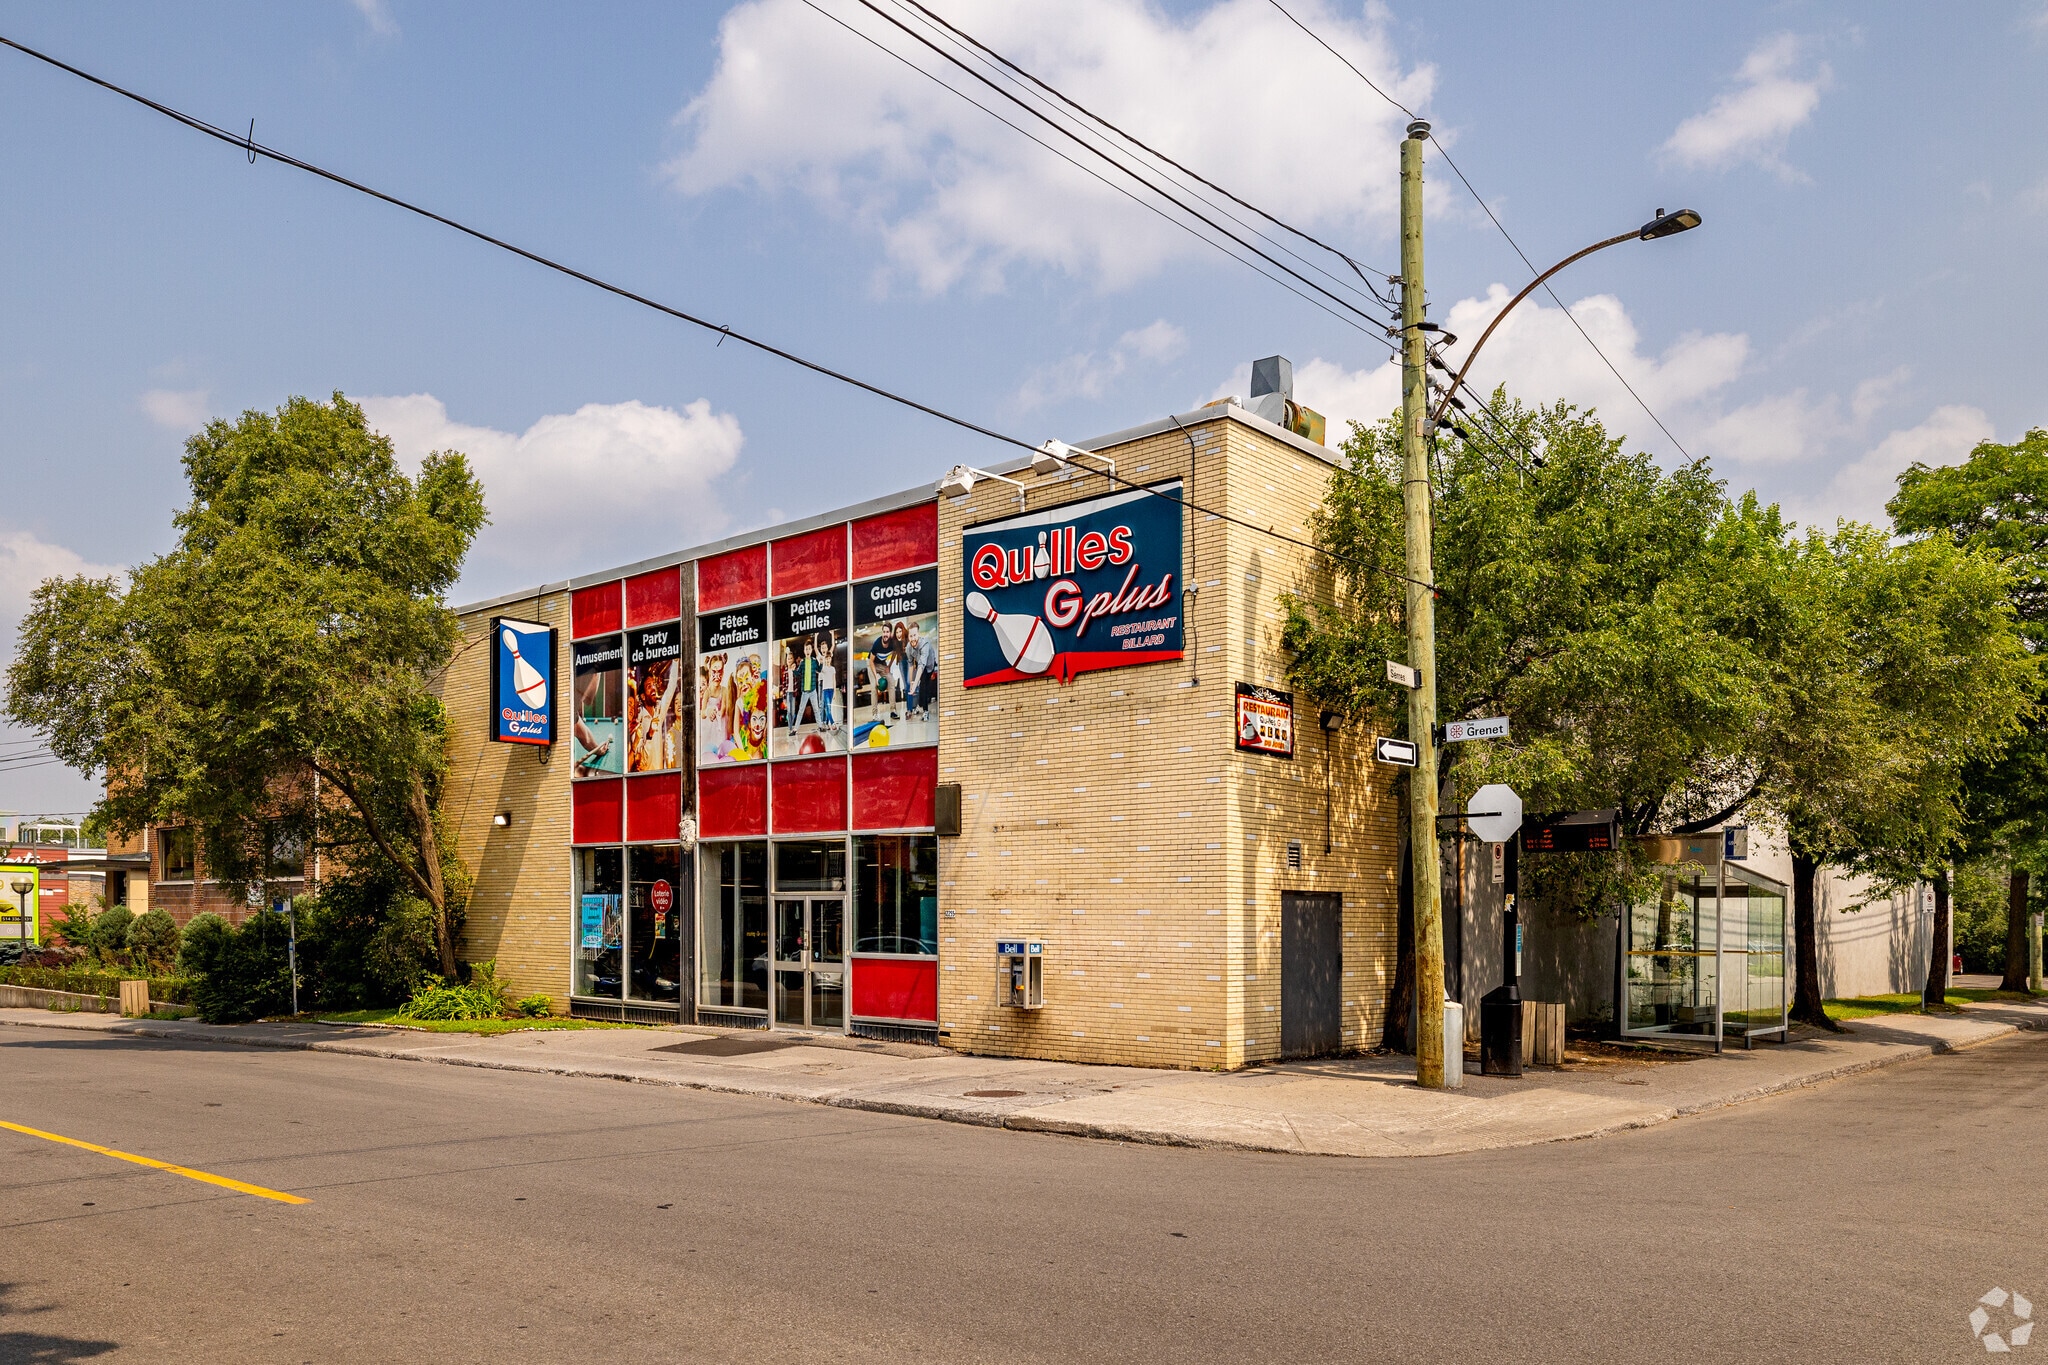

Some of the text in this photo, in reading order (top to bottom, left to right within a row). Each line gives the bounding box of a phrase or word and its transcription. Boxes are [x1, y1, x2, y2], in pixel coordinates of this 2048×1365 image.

[971, 525, 1134, 591] Quilles
[870, 579, 922, 601] Grosses
[790, 598, 831, 617] Petites
[874, 598, 918, 619] quilles
[719, 614, 749, 631] Fêtes
[791, 614, 830, 635] quilles
[1110, 616, 1177, 637] RESTAURANT
[642, 631, 669, 646] Party
[709, 626, 759, 647] d'enfants
[1122, 634, 1165, 650] BILLARD
[575, 646, 624, 666] Amusement
[631, 644, 680, 663] de bureau
[502, 707, 548, 725] Quilles
[1243, 700, 1289, 720] RESTAURANT
[1466, 725, 1504, 737] Grenet
[653, 890, 670, 898] Loterie
[1004, 943, 1040, 953] Bell Bell
